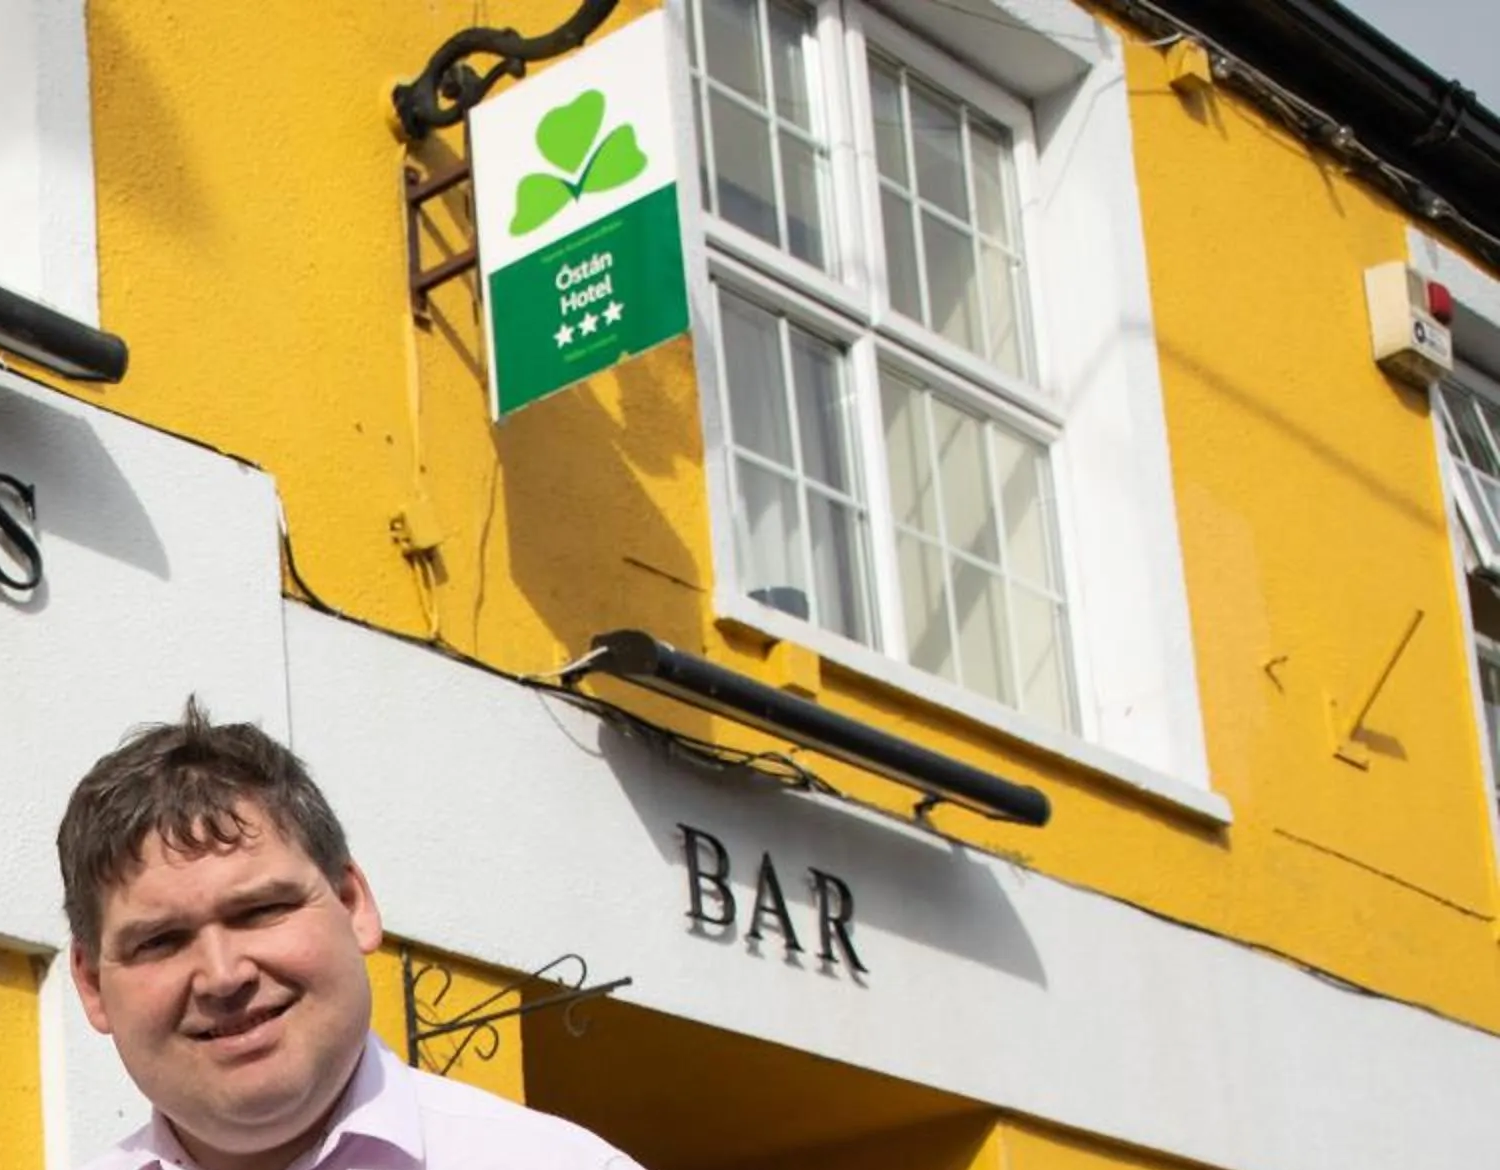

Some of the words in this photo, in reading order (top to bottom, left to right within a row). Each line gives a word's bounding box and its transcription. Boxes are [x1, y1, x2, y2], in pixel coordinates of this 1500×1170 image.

[555, 251, 612, 290] Óstán
[560, 272, 613, 316] Hotel
[675, 822, 870, 974] BAR
